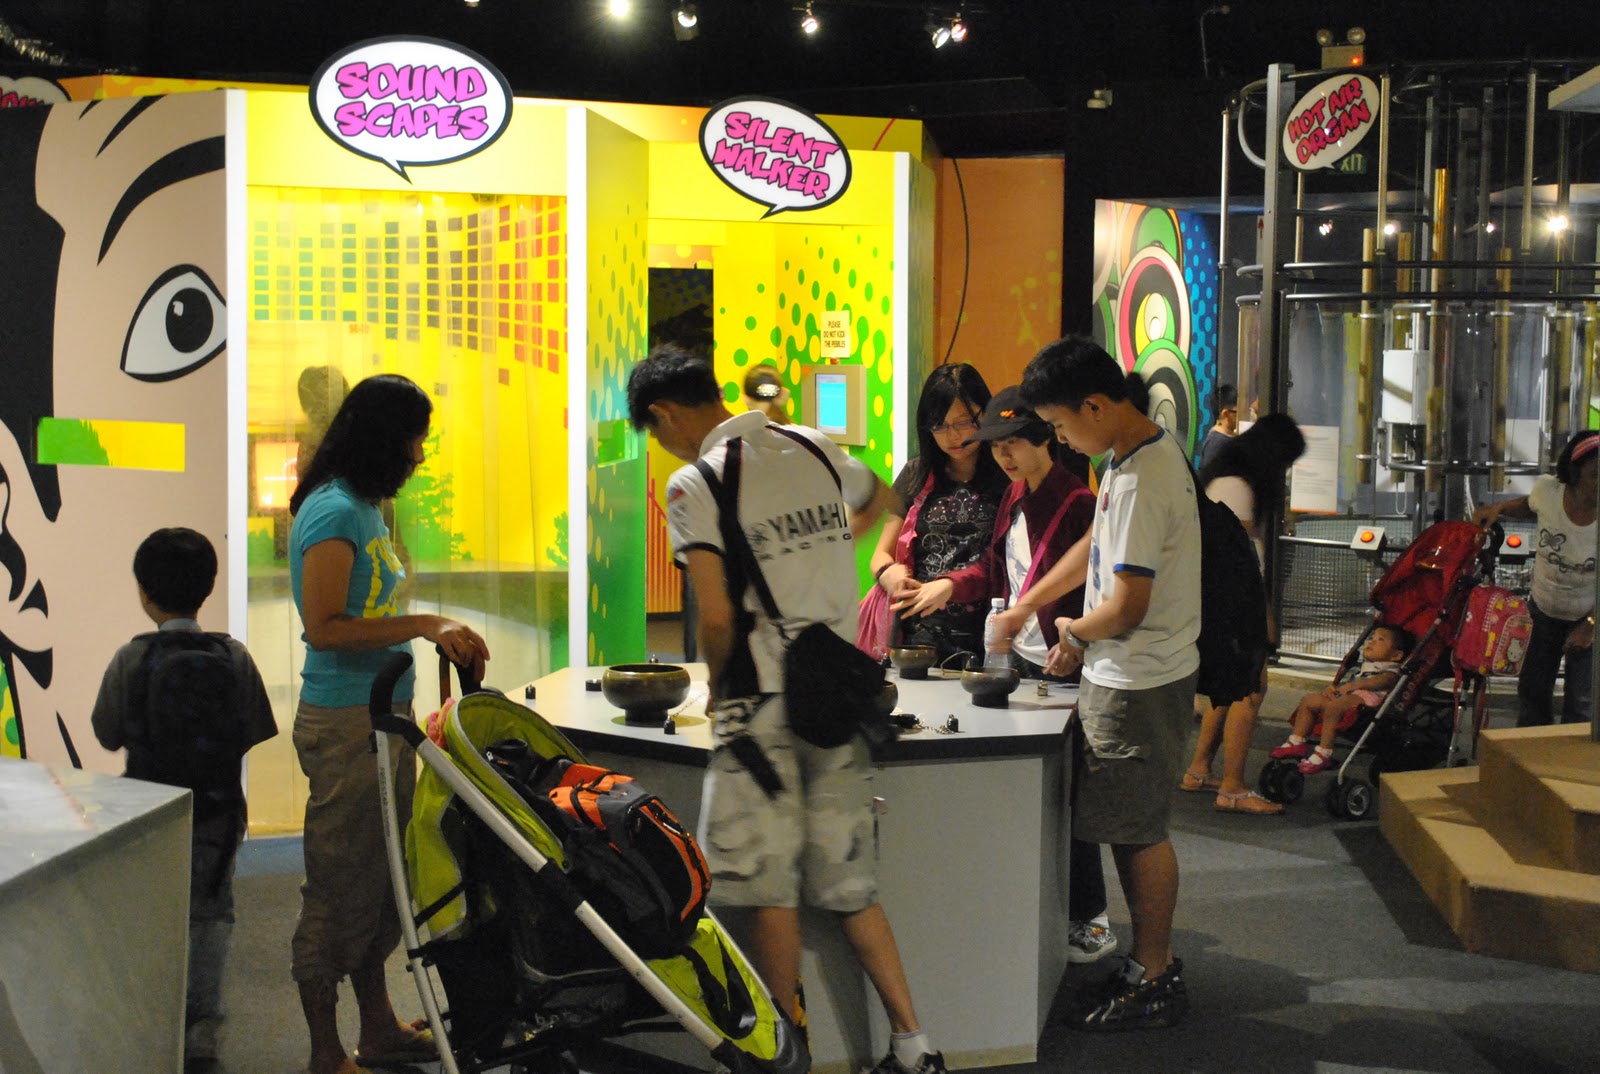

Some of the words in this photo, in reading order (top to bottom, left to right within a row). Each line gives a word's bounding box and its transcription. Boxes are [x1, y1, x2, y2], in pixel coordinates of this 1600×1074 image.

[335, 61, 488, 103] SOUND
[1287, 97, 1326, 144] HOT
[1328, 77, 1363, 116] AIR
[334, 101, 489, 140] SCAPES
[725, 111, 840, 169] SILENT
[1295, 98, 1372, 165] ORGAN
[712, 138, 831, 200] WALKER
[1341, 153, 1365, 171] XIT
